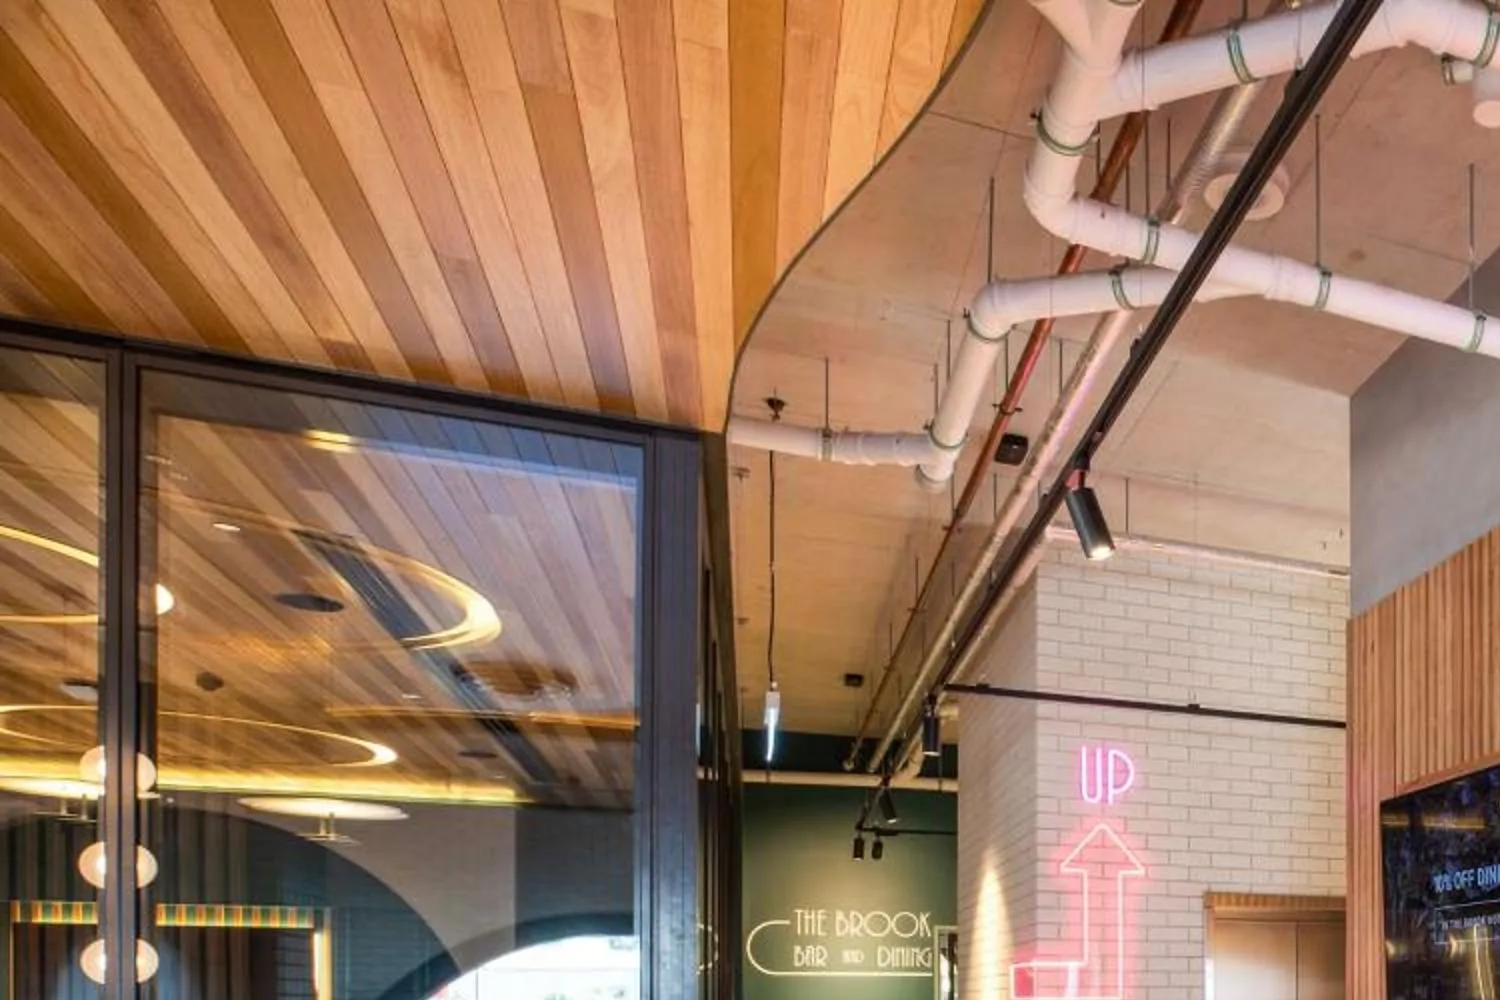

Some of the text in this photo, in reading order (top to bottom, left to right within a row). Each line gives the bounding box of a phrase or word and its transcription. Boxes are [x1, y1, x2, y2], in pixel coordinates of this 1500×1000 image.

[1081, 745, 1135, 805] UP
[1454, 869, 1475, 889] OFF
[793, 909, 932, 938] THE BROOK
[793, 944, 828, 967] BAR
[877, 944, 933, 968] DINING
